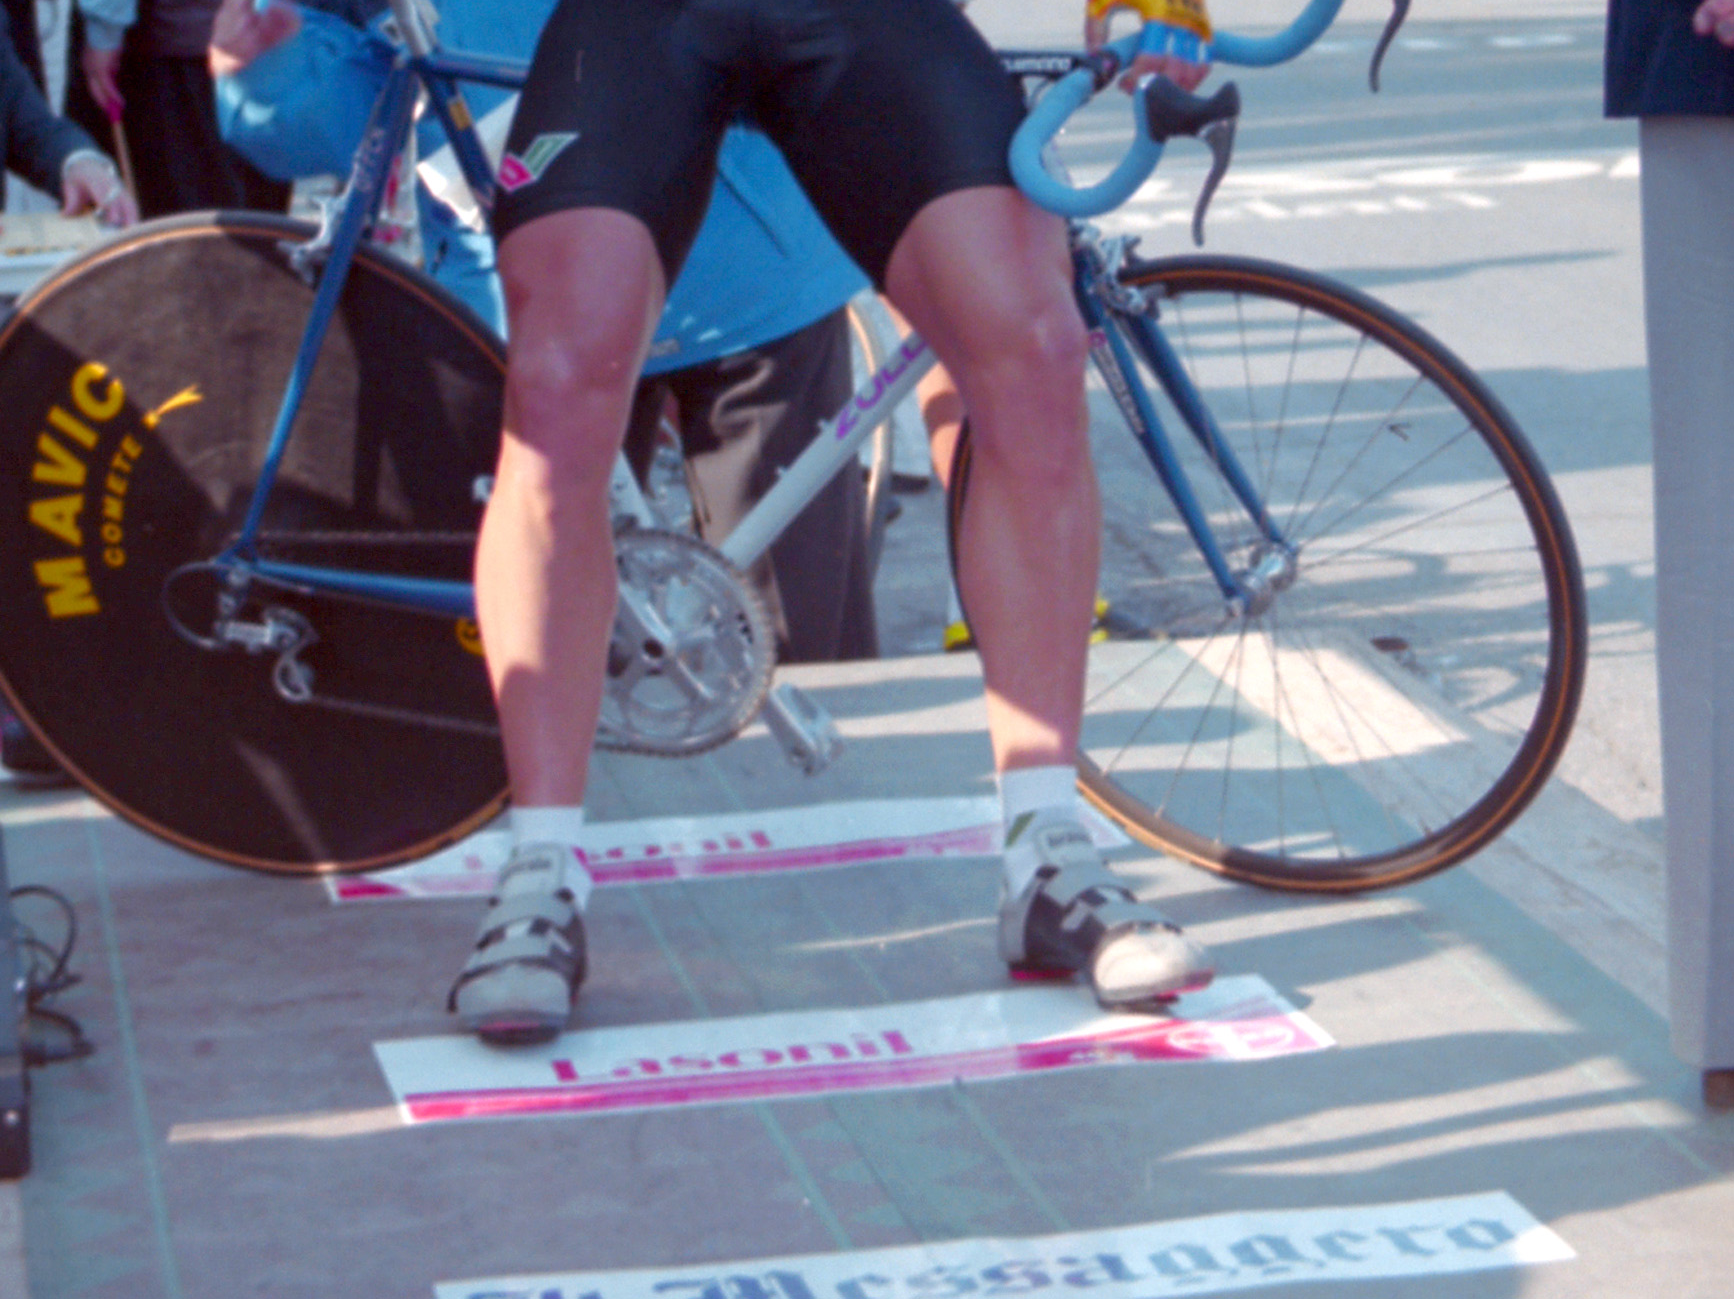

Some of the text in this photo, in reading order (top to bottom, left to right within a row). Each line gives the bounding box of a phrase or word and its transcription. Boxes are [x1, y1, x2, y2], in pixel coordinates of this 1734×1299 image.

[834, 339, 931, 441] ZULL
[28, 361, 126, 620] MAVIC
[99, 434, 144, 569] COMETE
[550, 1029, 913, 1084] Lasonil
